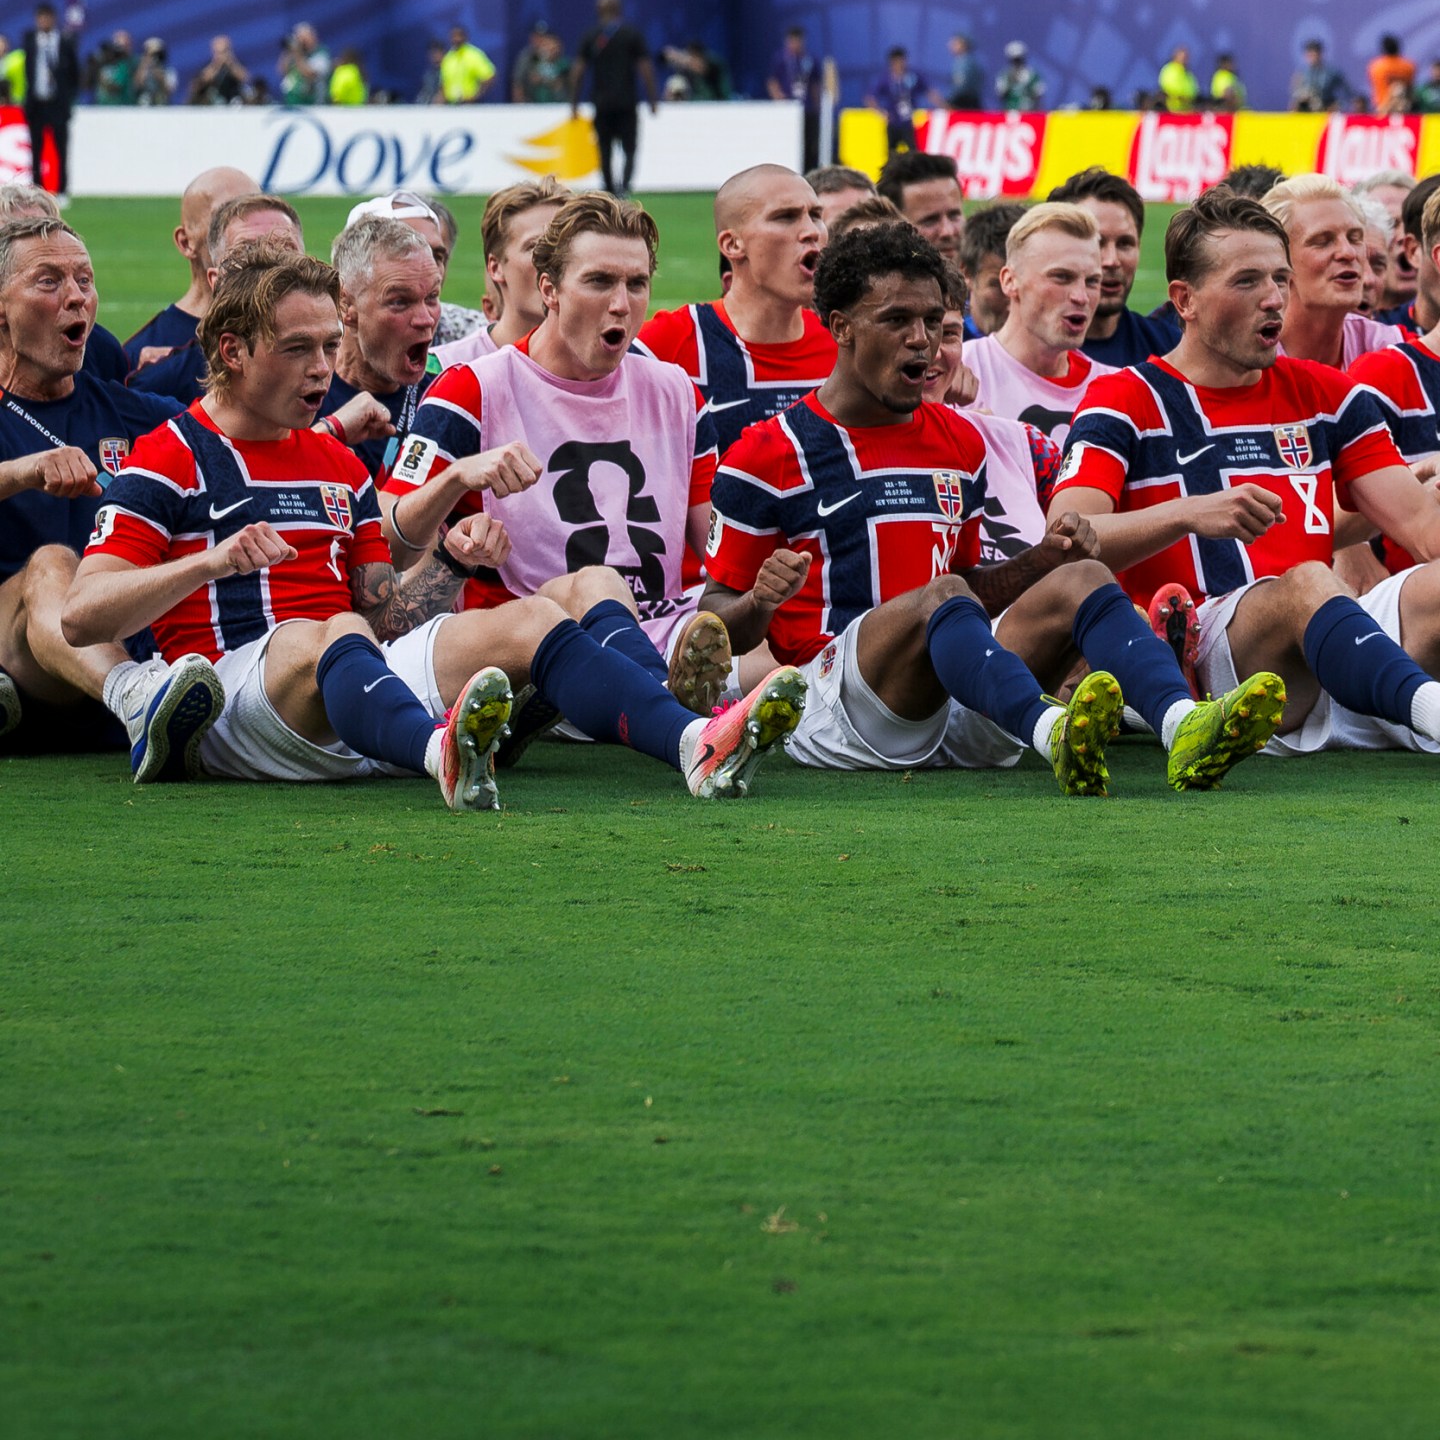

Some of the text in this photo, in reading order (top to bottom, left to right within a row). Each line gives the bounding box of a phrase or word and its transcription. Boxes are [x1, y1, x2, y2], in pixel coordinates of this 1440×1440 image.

[262, 106, 475, 194] Dove
[7, 401, 24, 417] FIFA
[24, 412, 51, 438] WORLD
[1288, 474, 1330, 534] 8
